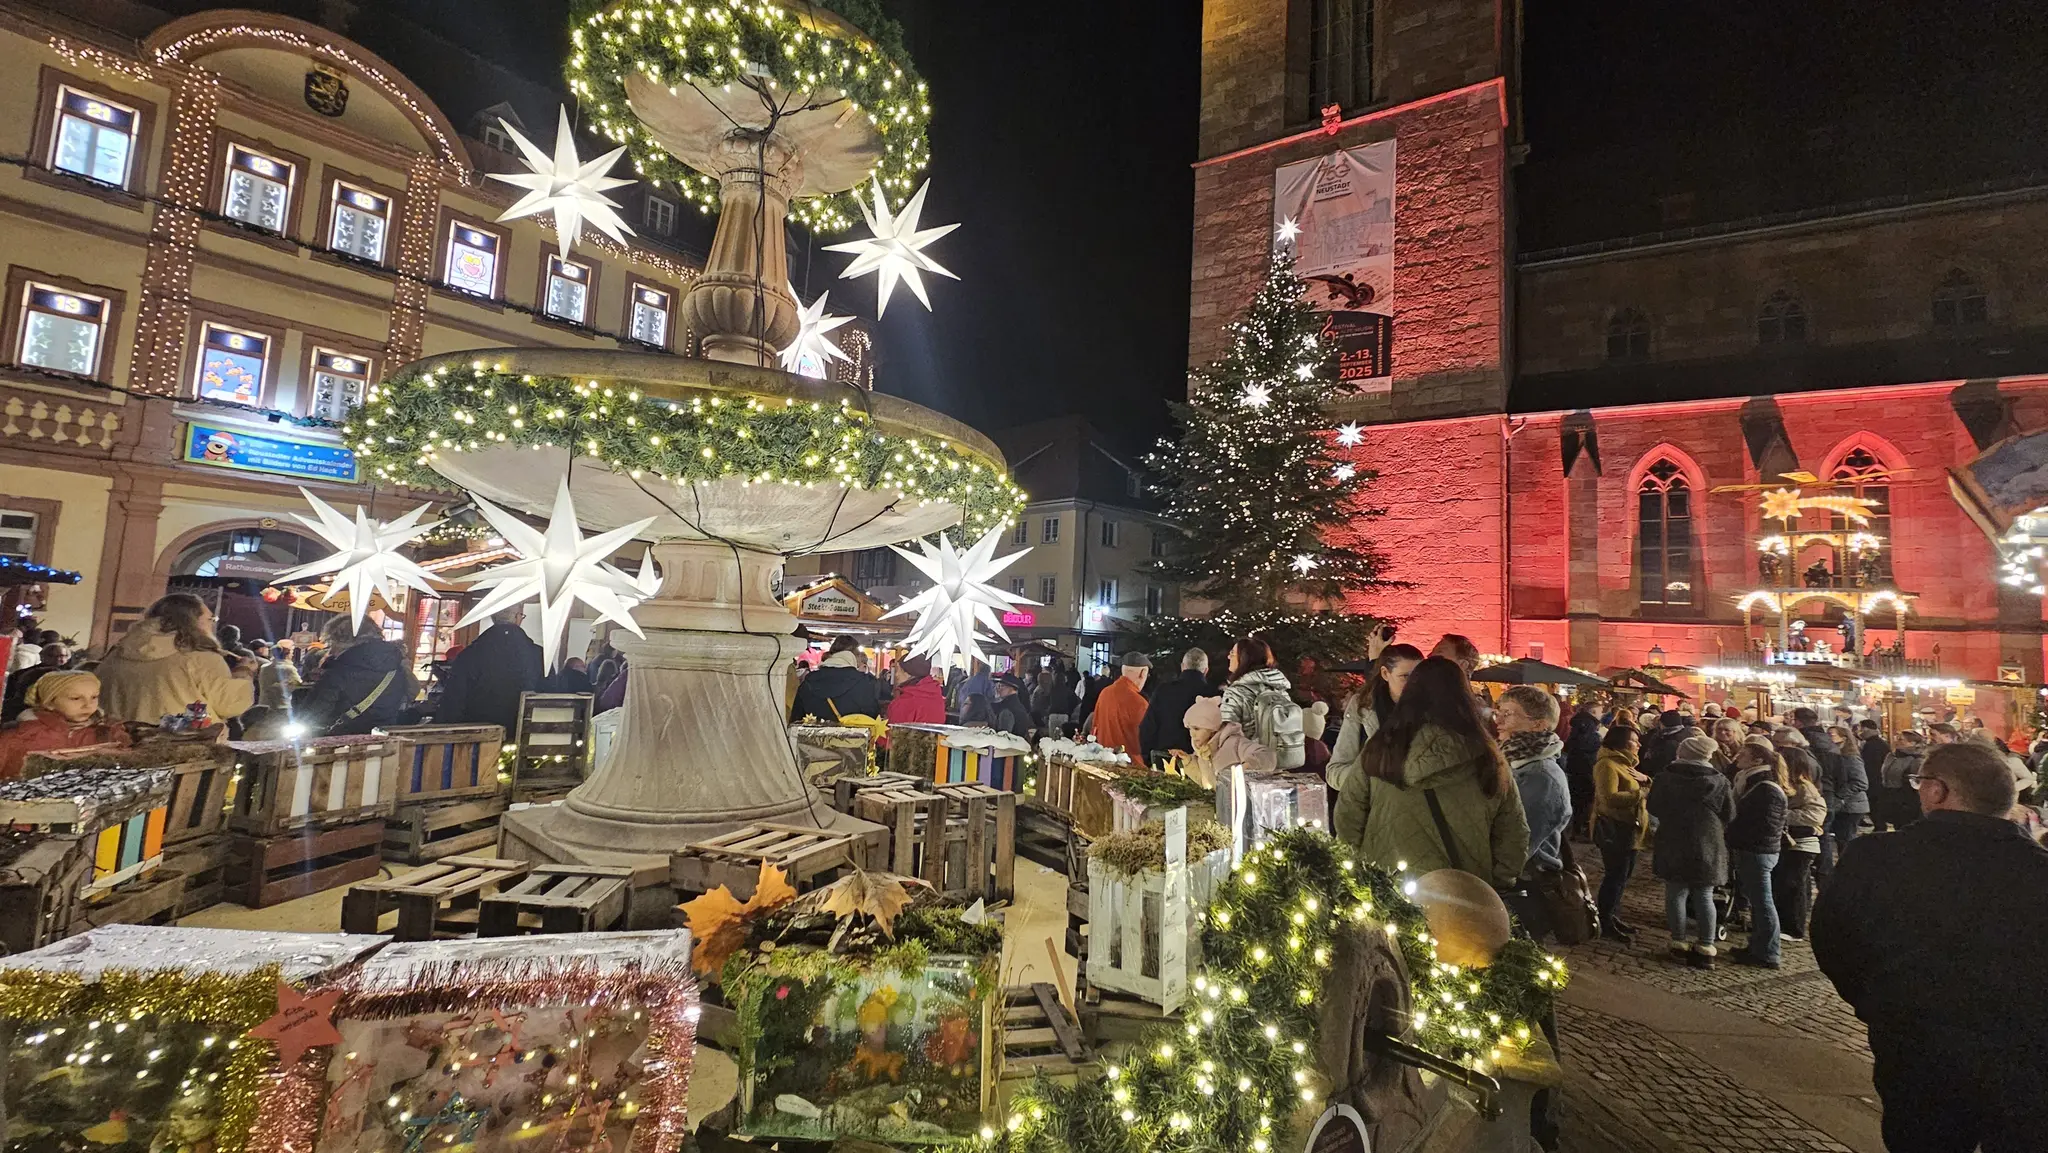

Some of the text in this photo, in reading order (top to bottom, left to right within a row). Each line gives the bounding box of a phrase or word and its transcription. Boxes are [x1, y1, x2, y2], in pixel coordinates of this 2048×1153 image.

[87, 102, 111, 121] 21
[252, 157, 273, 175] 12
[1316, 181, 1351, 194] NEUSTADT
[230, 334, 243, 349] 6
[332, 357, 353, 372] 24
[1340, 359, 1373, 368] SEPTEMBER
[1340, 366, 1373, 379] 2025
[262, 458, 291, 468] Bildern
[292, 456, 353, 469] Adventskalender
[817, 597, 846, 605] Bratwürste
